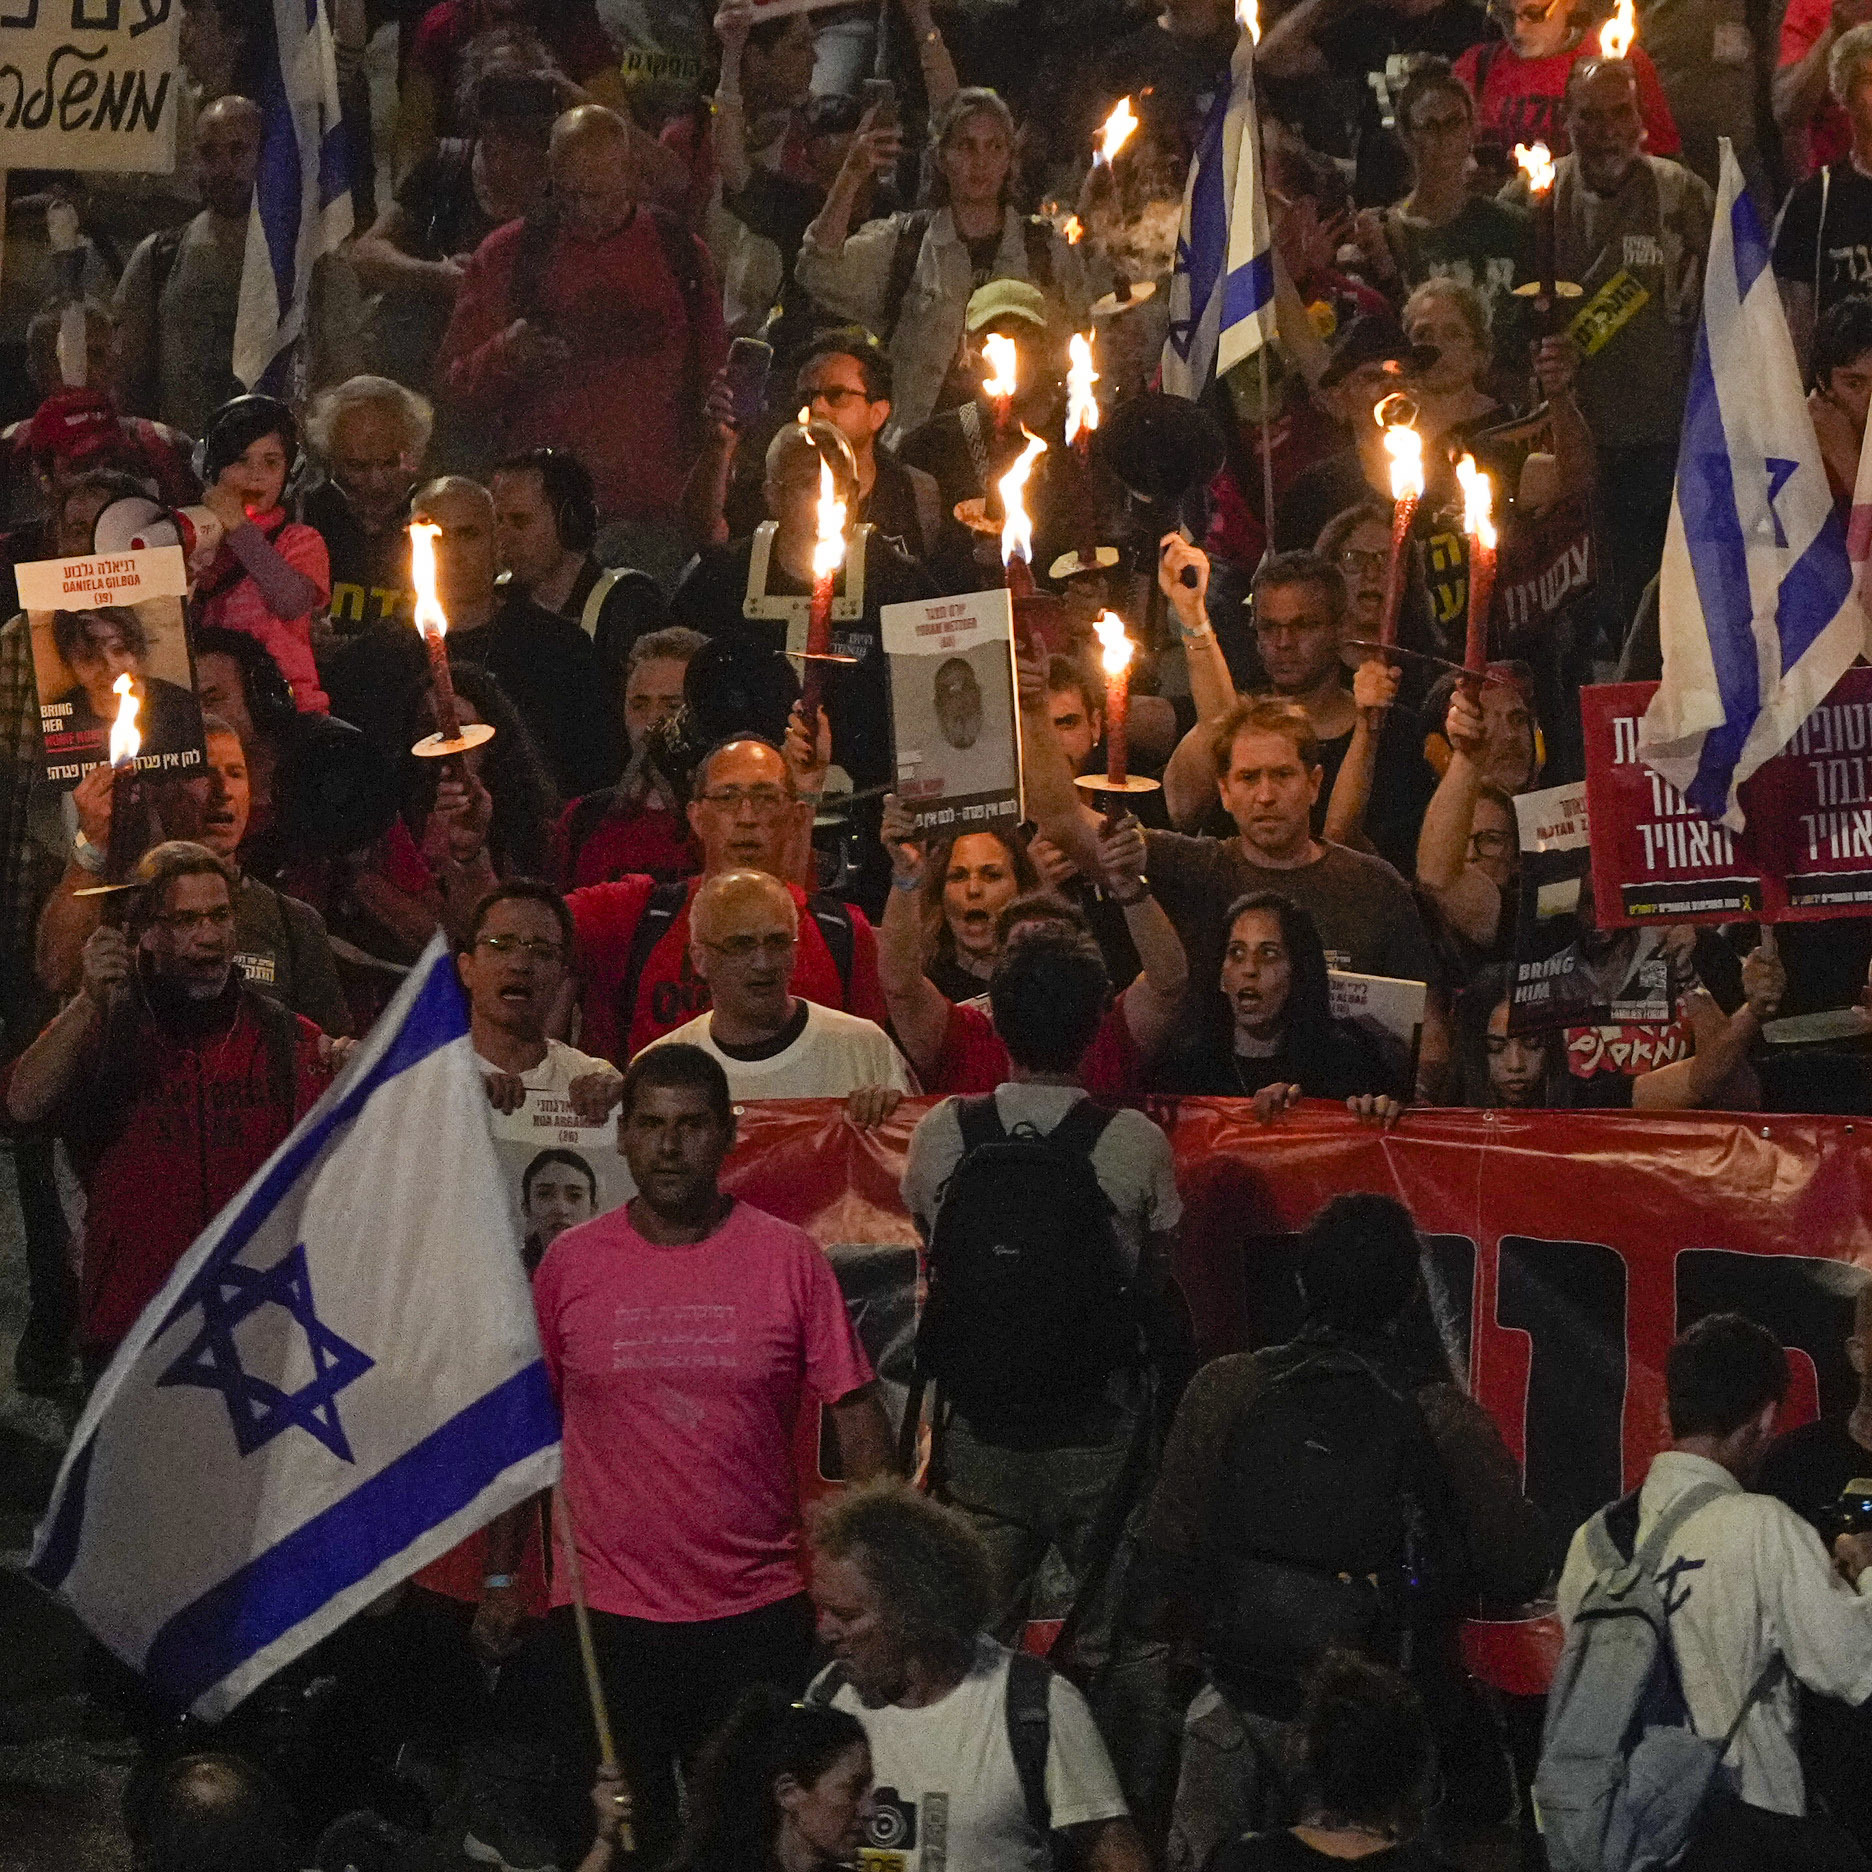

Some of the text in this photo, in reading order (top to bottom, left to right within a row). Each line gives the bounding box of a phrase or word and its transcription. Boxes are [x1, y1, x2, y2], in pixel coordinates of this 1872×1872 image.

[63, 576, 141, 593] DANIELA GILBOA
[40, 702, 73, 719] BRING
[42, 718, 64, 733] HER
[1518, 956, 1576, 983] BRING
[1514, 981, 1551, 1005] HIM
